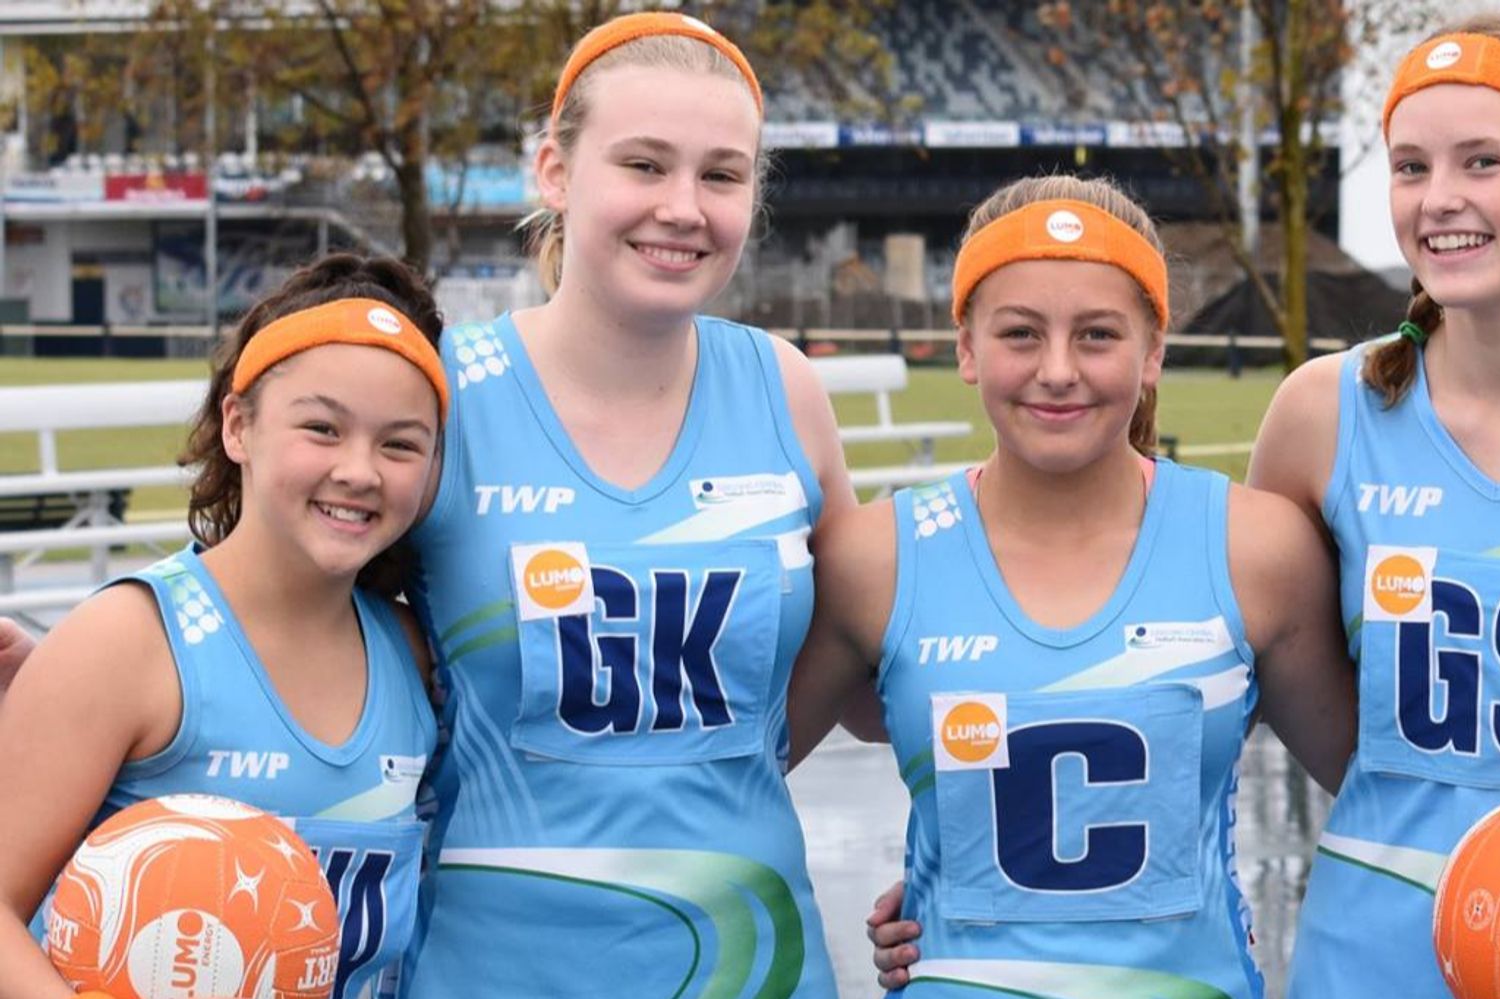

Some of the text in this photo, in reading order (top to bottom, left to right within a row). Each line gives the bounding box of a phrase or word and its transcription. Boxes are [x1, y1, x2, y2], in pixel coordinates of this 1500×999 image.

[474, 484, 576, 515] TWP
[1357, 482, 1443, 517] TWP
[528, 566, 585, 588] LUMO
[1376, 575, 1426, 593] LUMO
[553, 563, 746, 737] GK
[917, 634, 998, 665] TWP
[945, 720, 1001, 741] LUMO
[205, 749, 290, 779] TWP
[990, 717, 1149, 895] C
[170, 910, 204, 999] UMO
